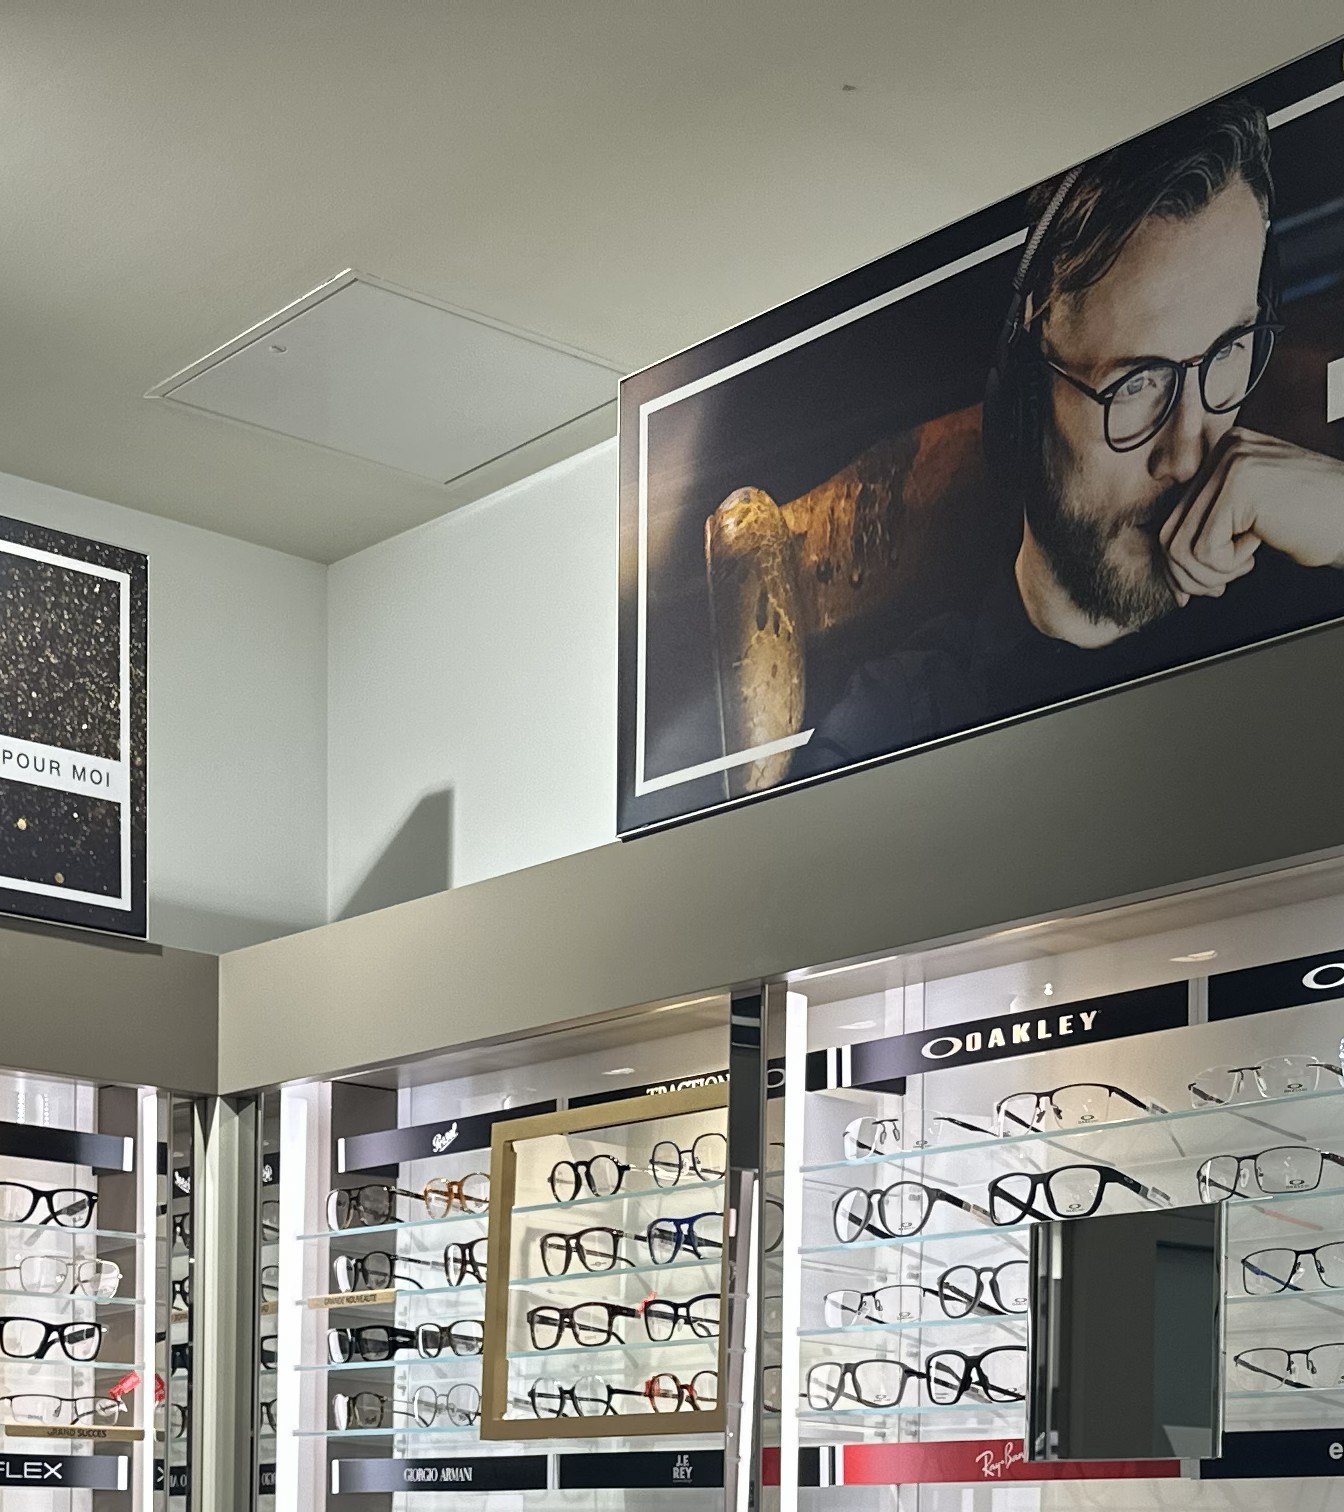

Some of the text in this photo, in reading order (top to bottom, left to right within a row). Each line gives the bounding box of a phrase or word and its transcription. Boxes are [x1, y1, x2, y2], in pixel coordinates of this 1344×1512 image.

[1, 748, 61, 777] POUR
[71, 765, 111, 788] MOI
[965, 1010, 1100, 1053] OAKLEY
[646, 1074, 732, 1096] CTION
[672, 1467, 693, 1479] REY
[975, 1441, 1026, 1477] Ray-Ban
[403, 1467, 473, 1483] GIORGIO ARMANI
